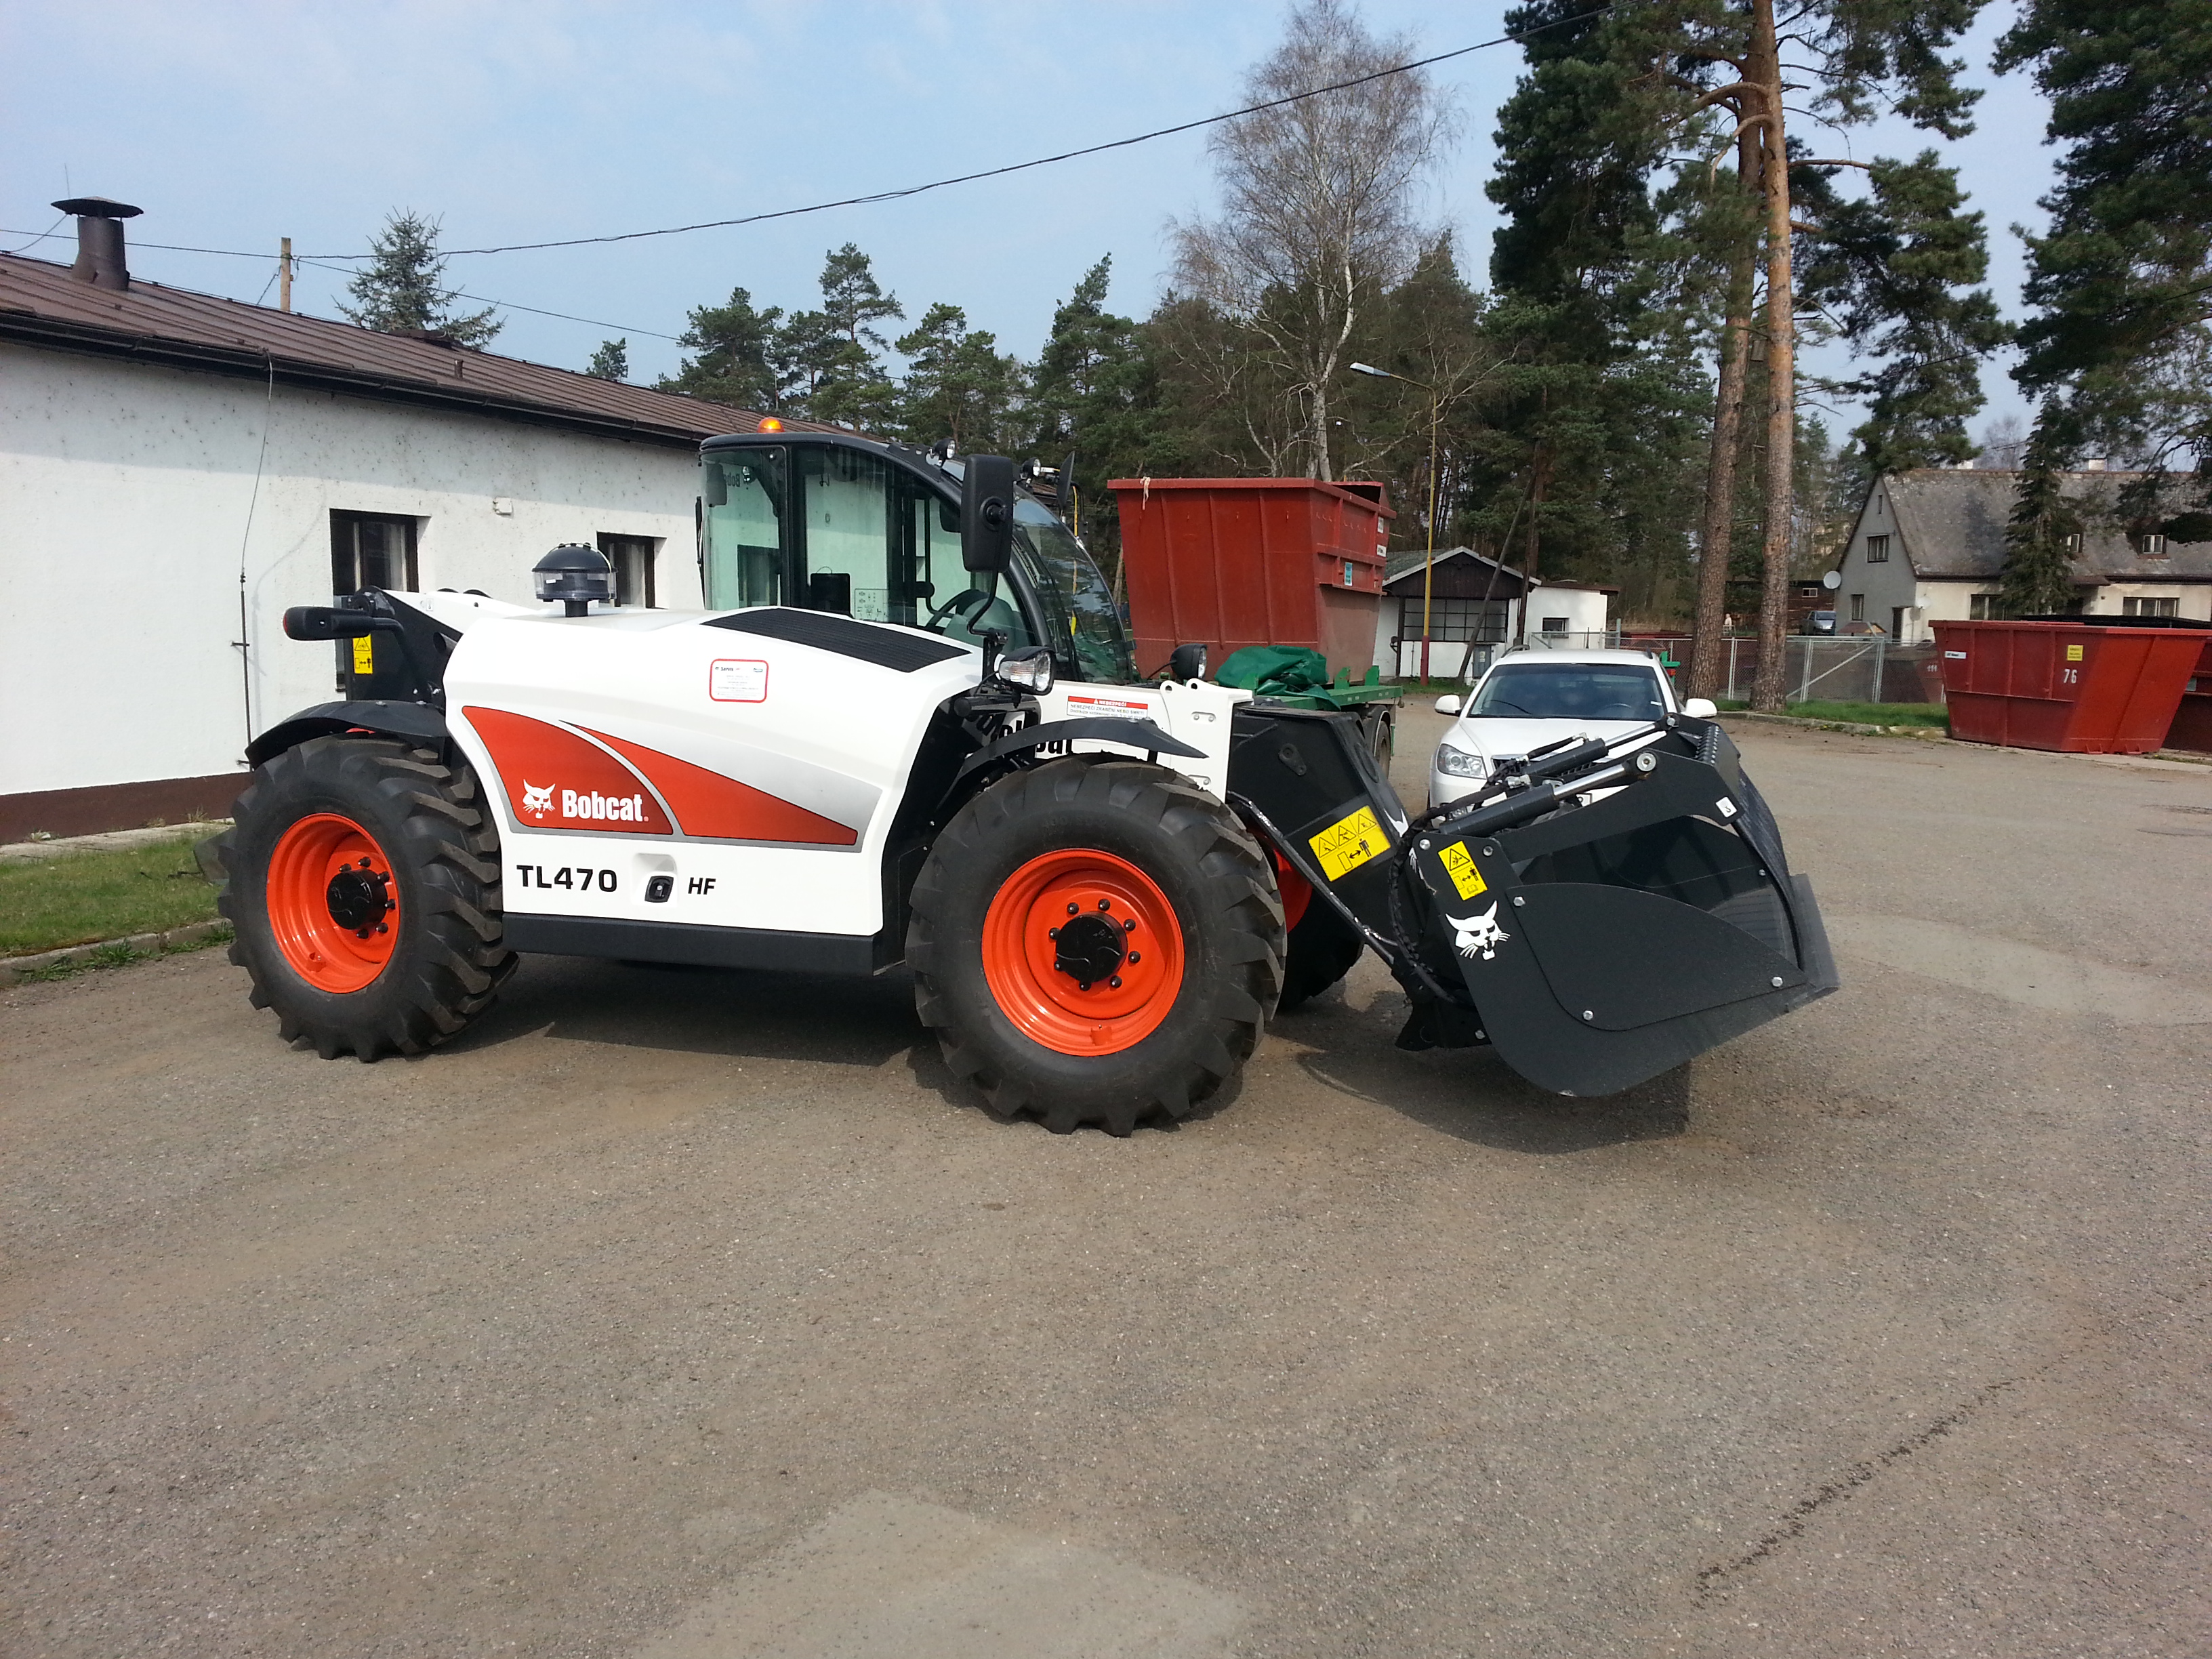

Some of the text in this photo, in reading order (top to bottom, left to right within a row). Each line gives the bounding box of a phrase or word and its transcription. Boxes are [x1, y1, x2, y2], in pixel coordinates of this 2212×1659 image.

[2064, 668, 2077, 684] 76
[516, 865, 716, 895] TL470 HF
